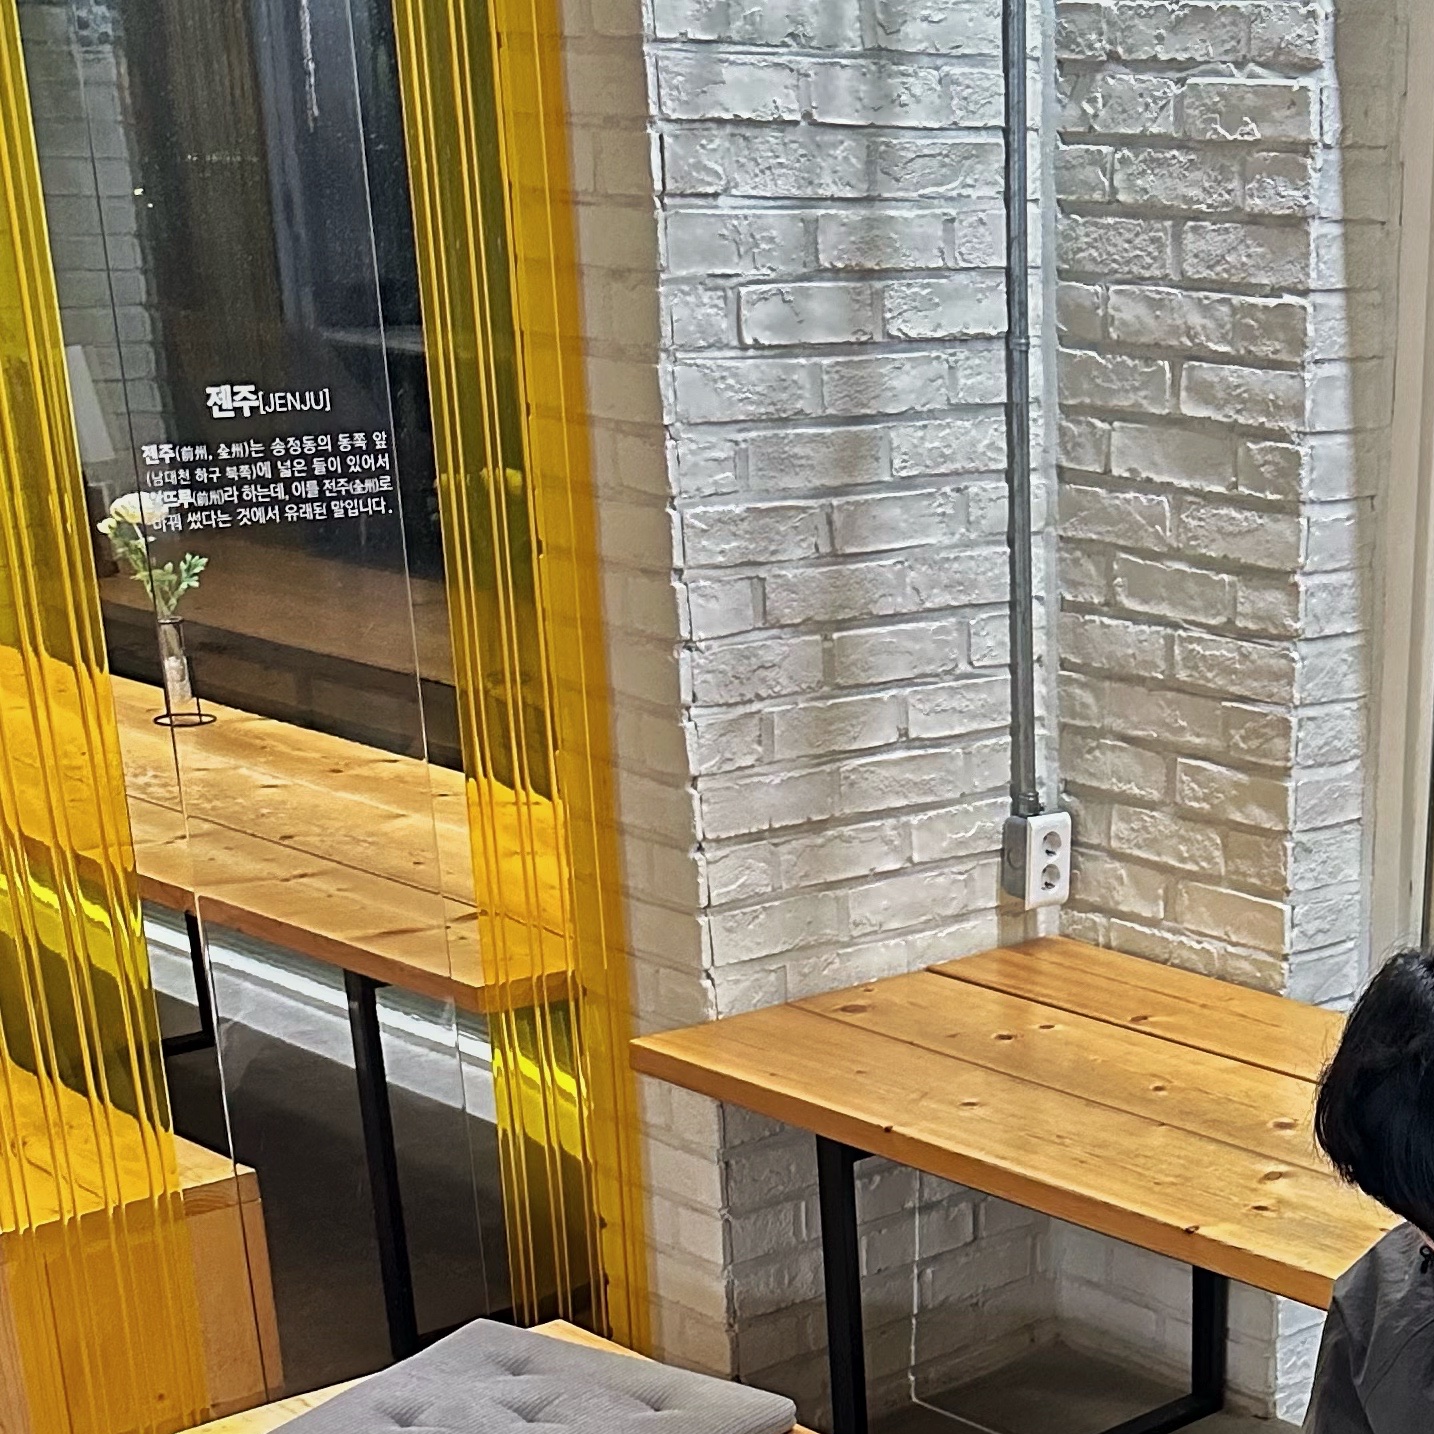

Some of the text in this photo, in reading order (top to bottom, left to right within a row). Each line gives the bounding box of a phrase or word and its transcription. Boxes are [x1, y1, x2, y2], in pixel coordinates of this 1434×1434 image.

[270, 434, 332, 456] 송정동의
[338, 432, 368, 452] 동쪽
[373, 431, 388, 450] 앞
[146, 453, 390, 487] (남대천 하구 북쪽)에 넓은 들이 있어서
[241, 483, 290, 502] 하는데,
[291, 480, 320, 498] 이를
[187, 510, 232, 529] 썼다는
[237, 505, 281, 525] 것에서
[284, 502, 328, 521] 유래된
[331, 496, 393, 518] 말입니다.
